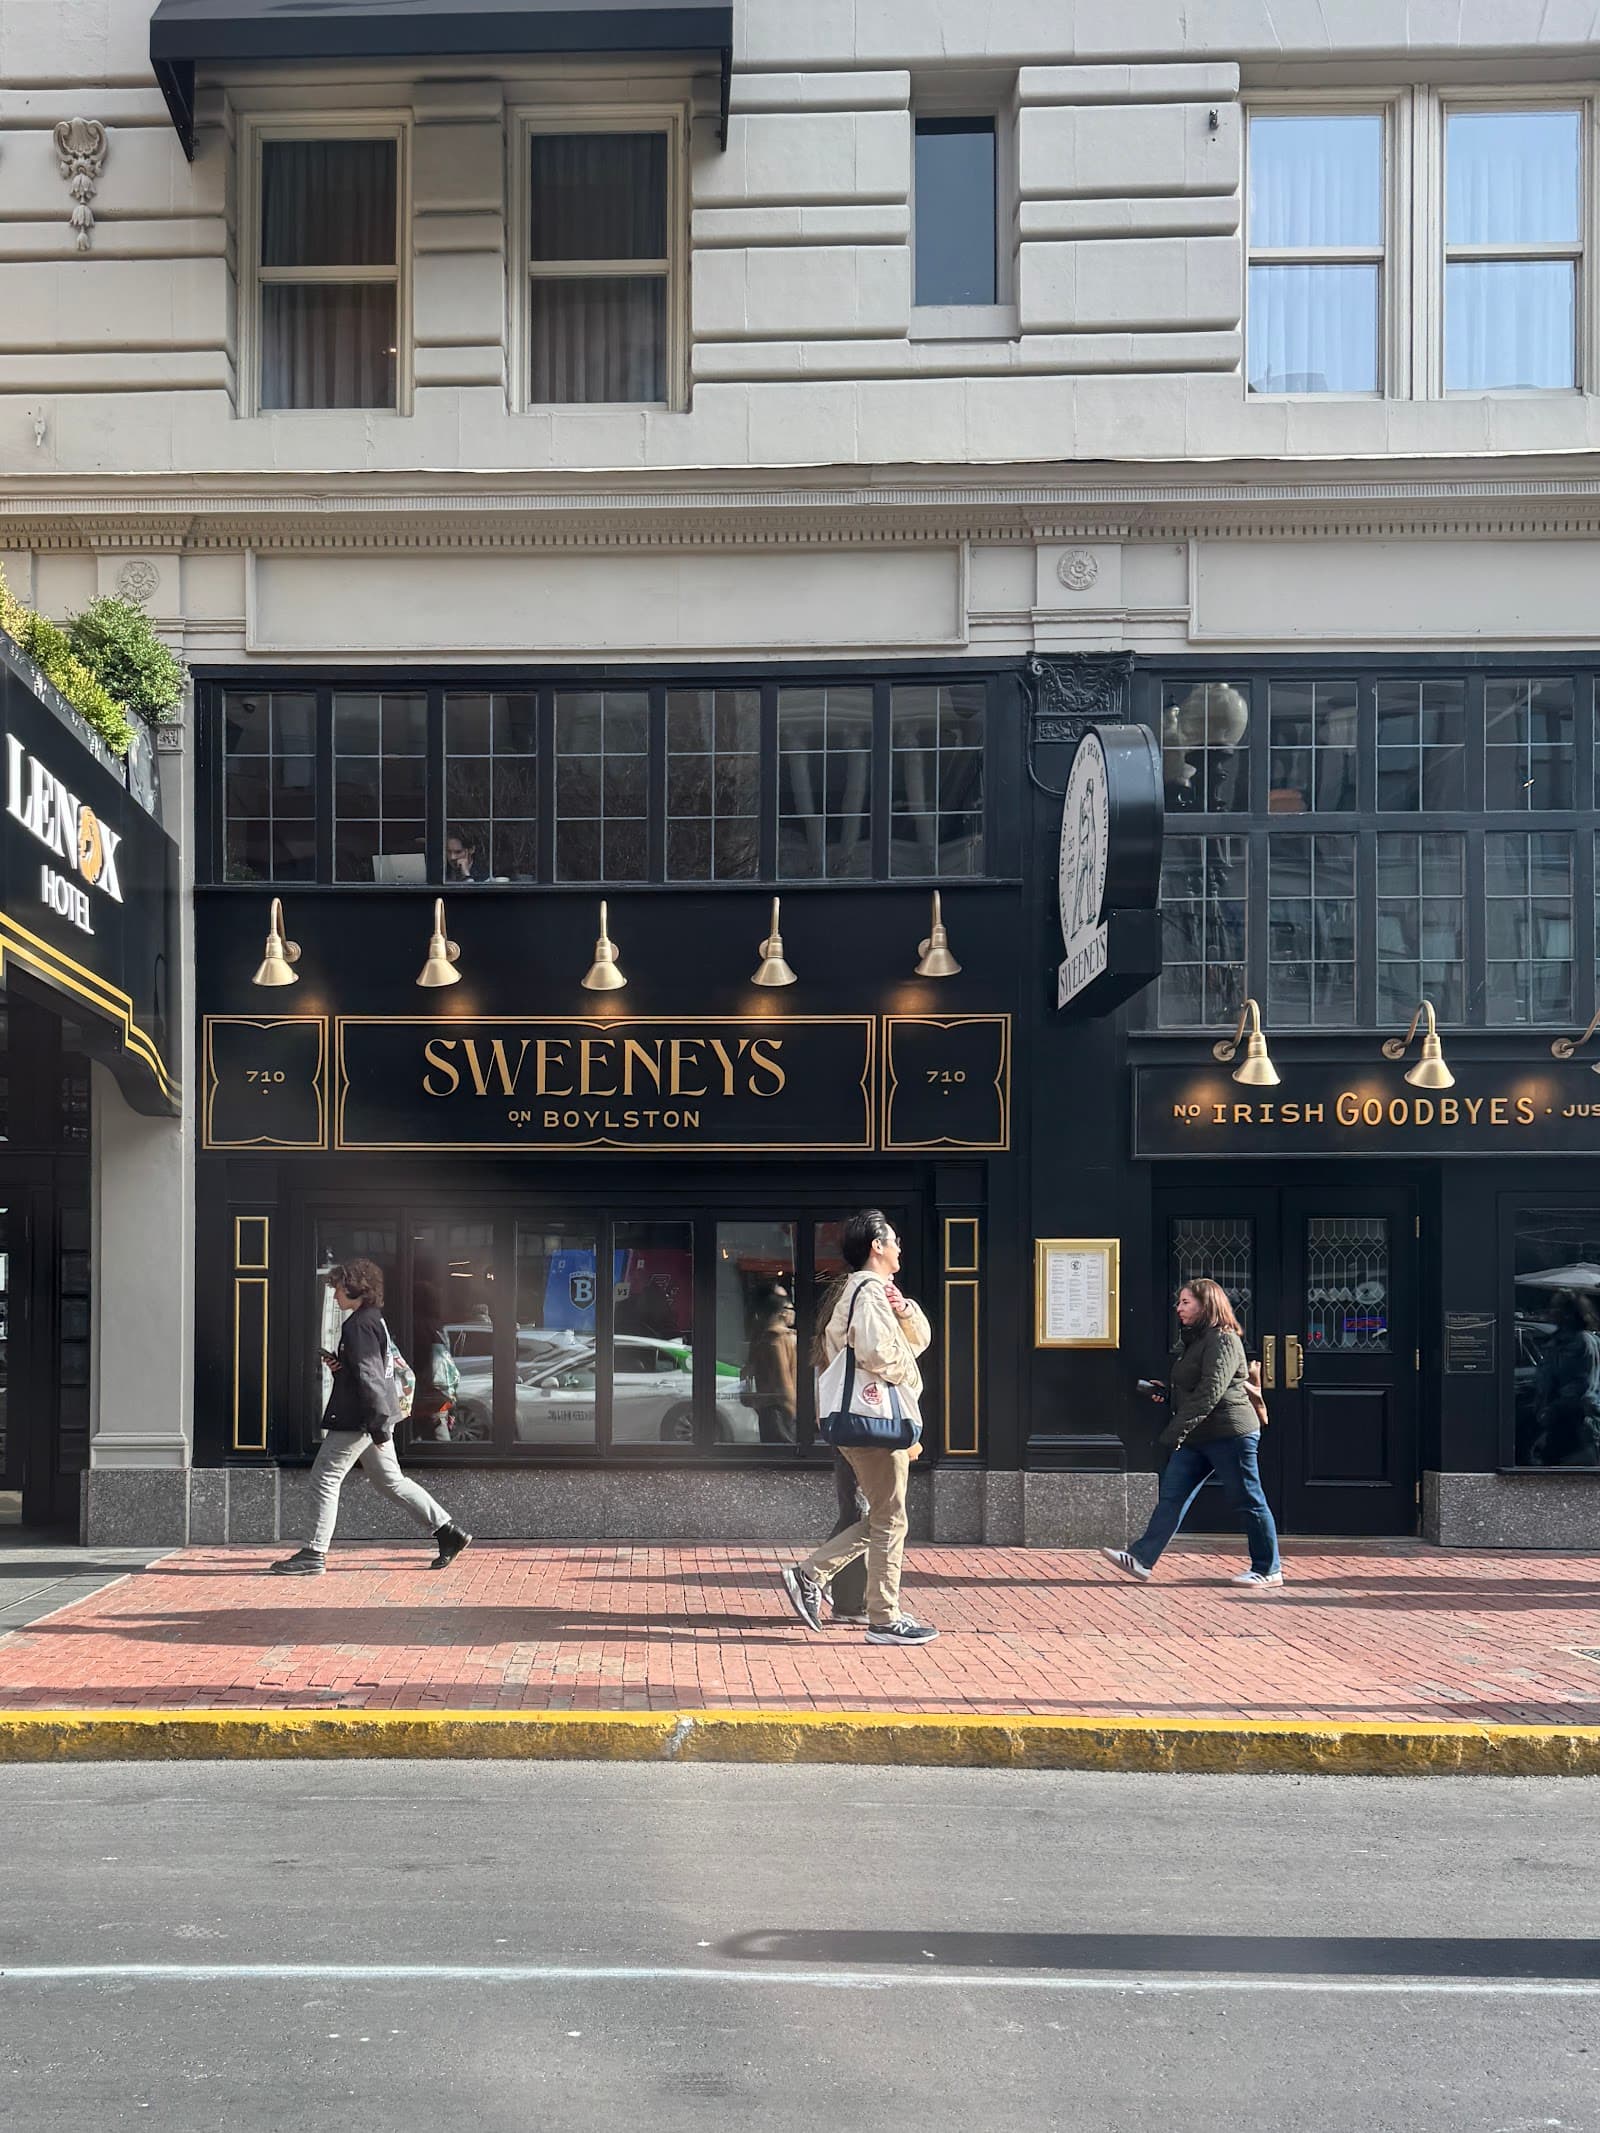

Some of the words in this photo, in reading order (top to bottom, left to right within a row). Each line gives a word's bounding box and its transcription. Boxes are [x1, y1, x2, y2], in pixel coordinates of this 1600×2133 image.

[41, 864, 95, 936] HOTEL
[245, 1070, 286, 1083] 710
[926, 1070, 967, 1083] 710
[1173, 1104, 1201, 1118] NO
[1212, 1103, 1324, 1125] IRISH
[1335, 1091, 1536, 1127] GOODBYES
[508, 1110, 532, 1122] ON
[543, 1110, 700, 1128] BOYLSTON
